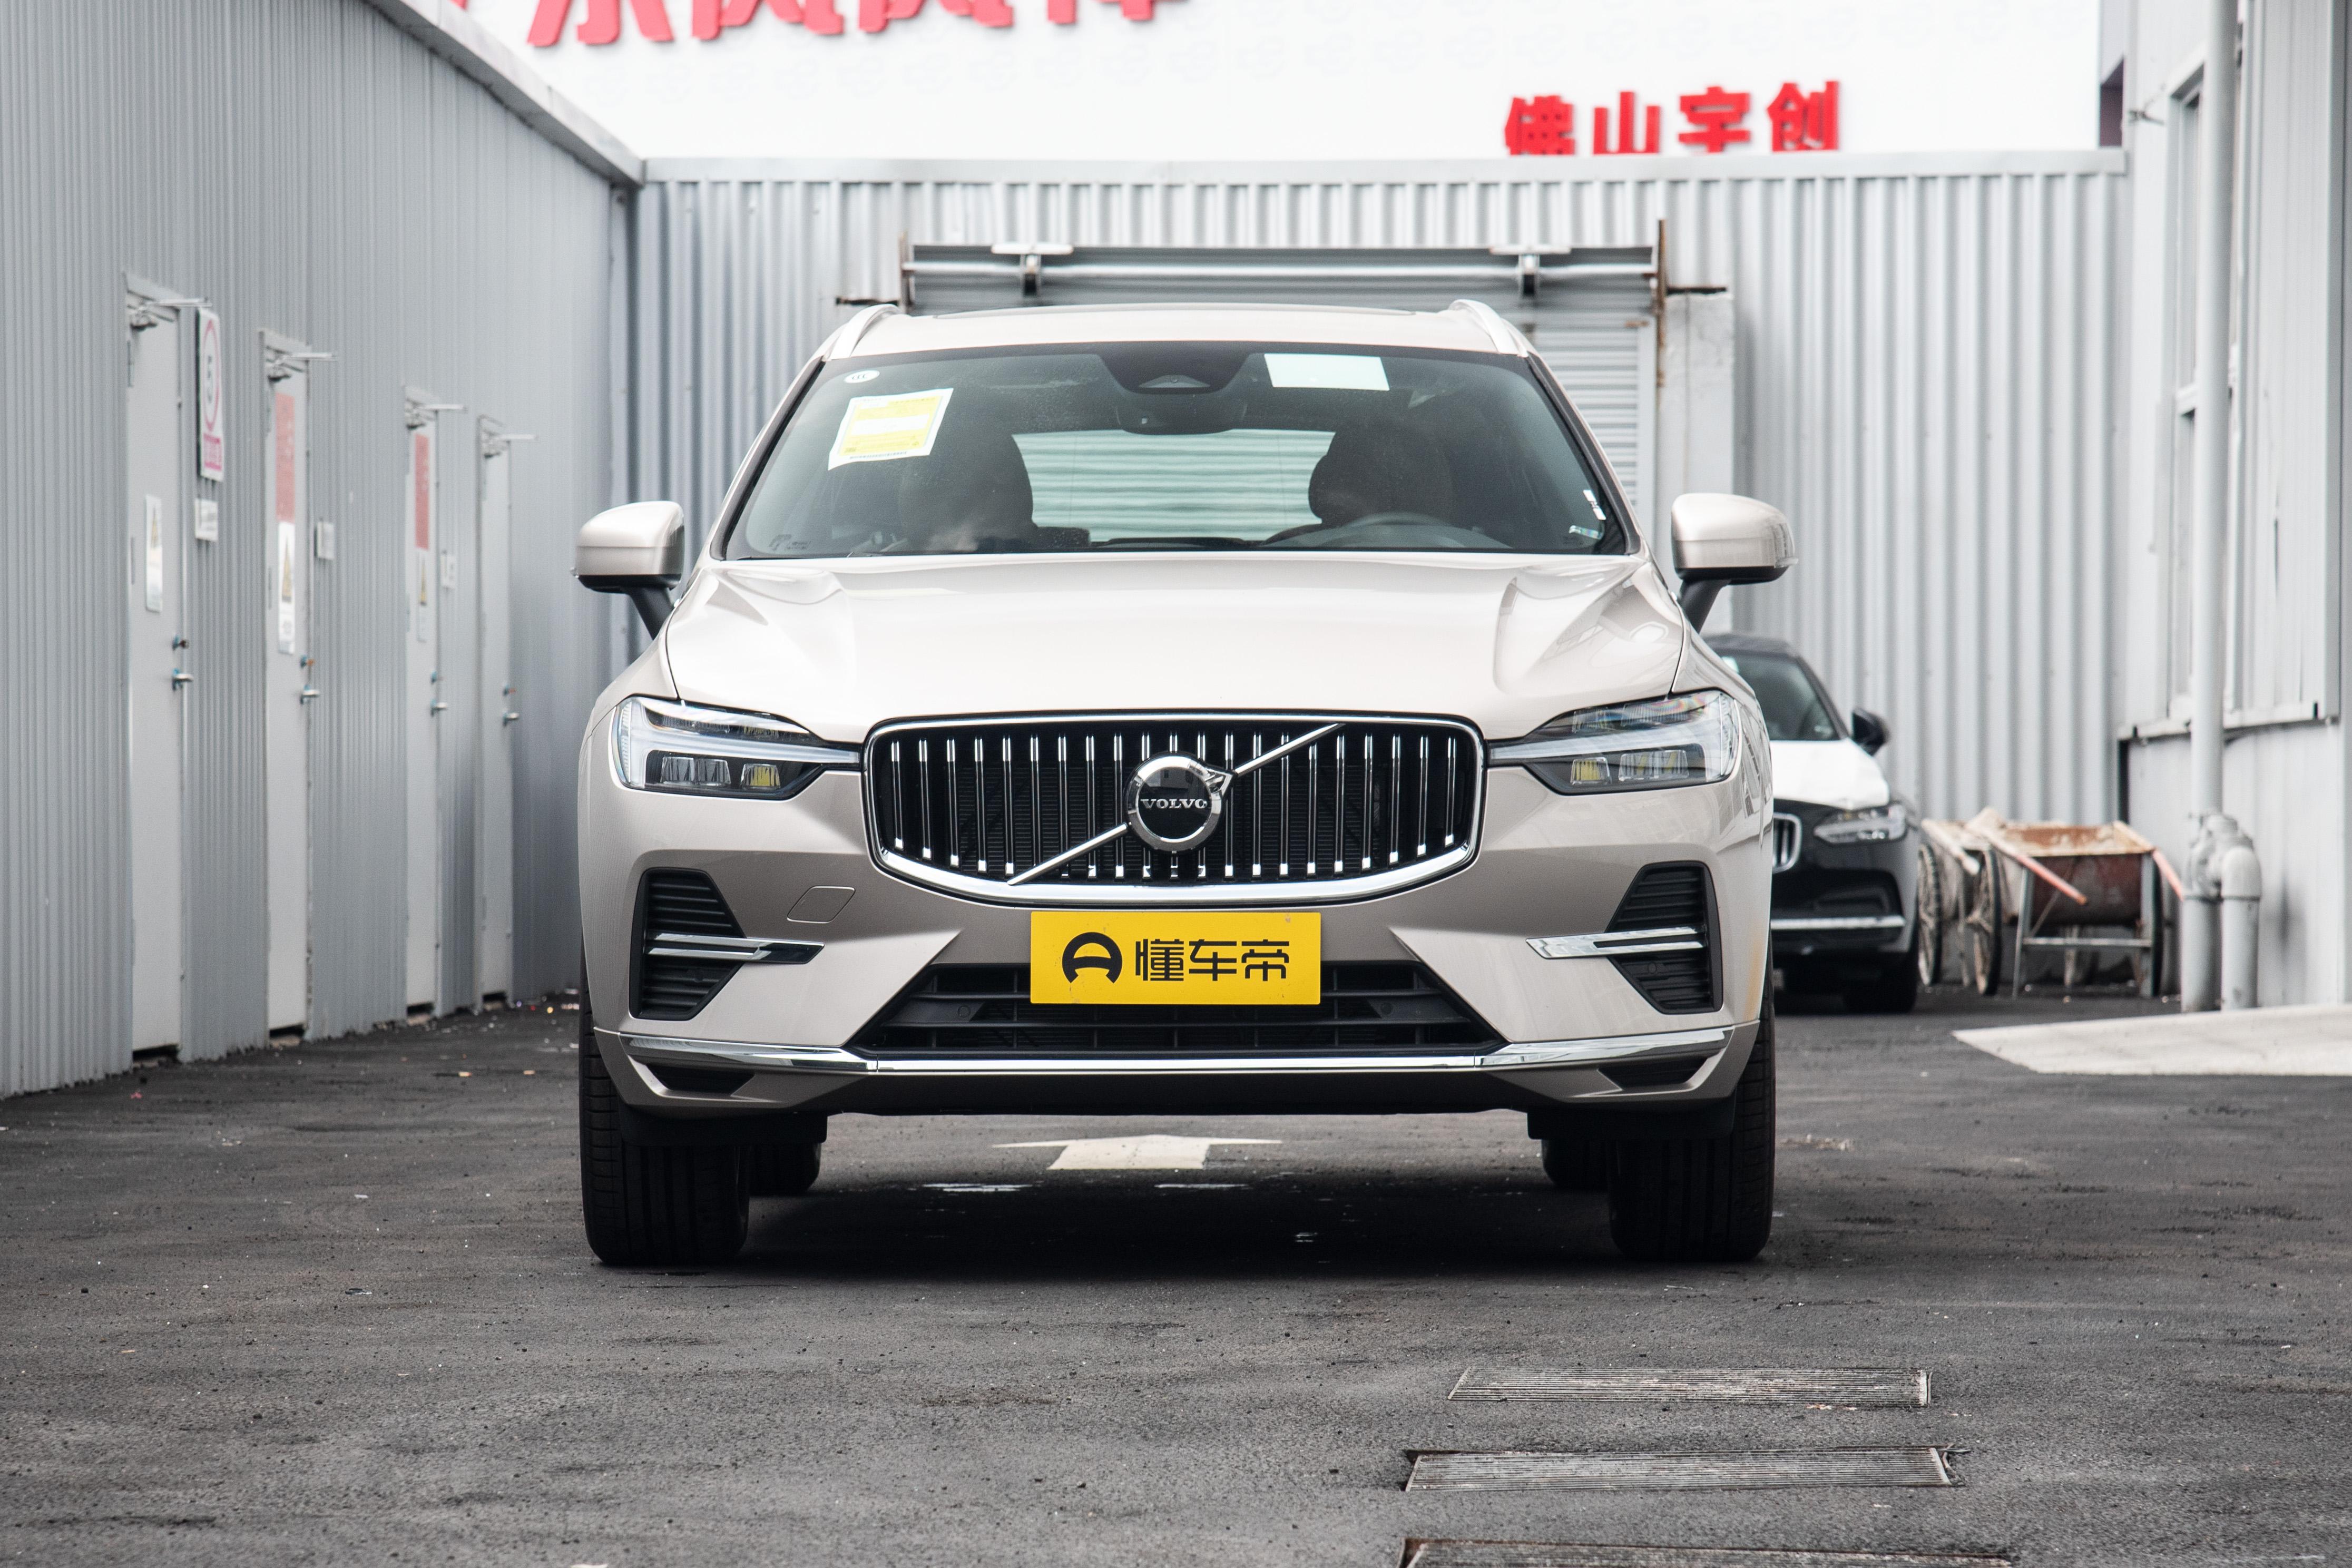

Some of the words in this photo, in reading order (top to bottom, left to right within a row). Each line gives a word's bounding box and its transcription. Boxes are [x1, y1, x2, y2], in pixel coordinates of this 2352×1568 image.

[1140, 799, 1208, 809] VOLVO
[1135, 938, 1290, 981] 懂车帝
